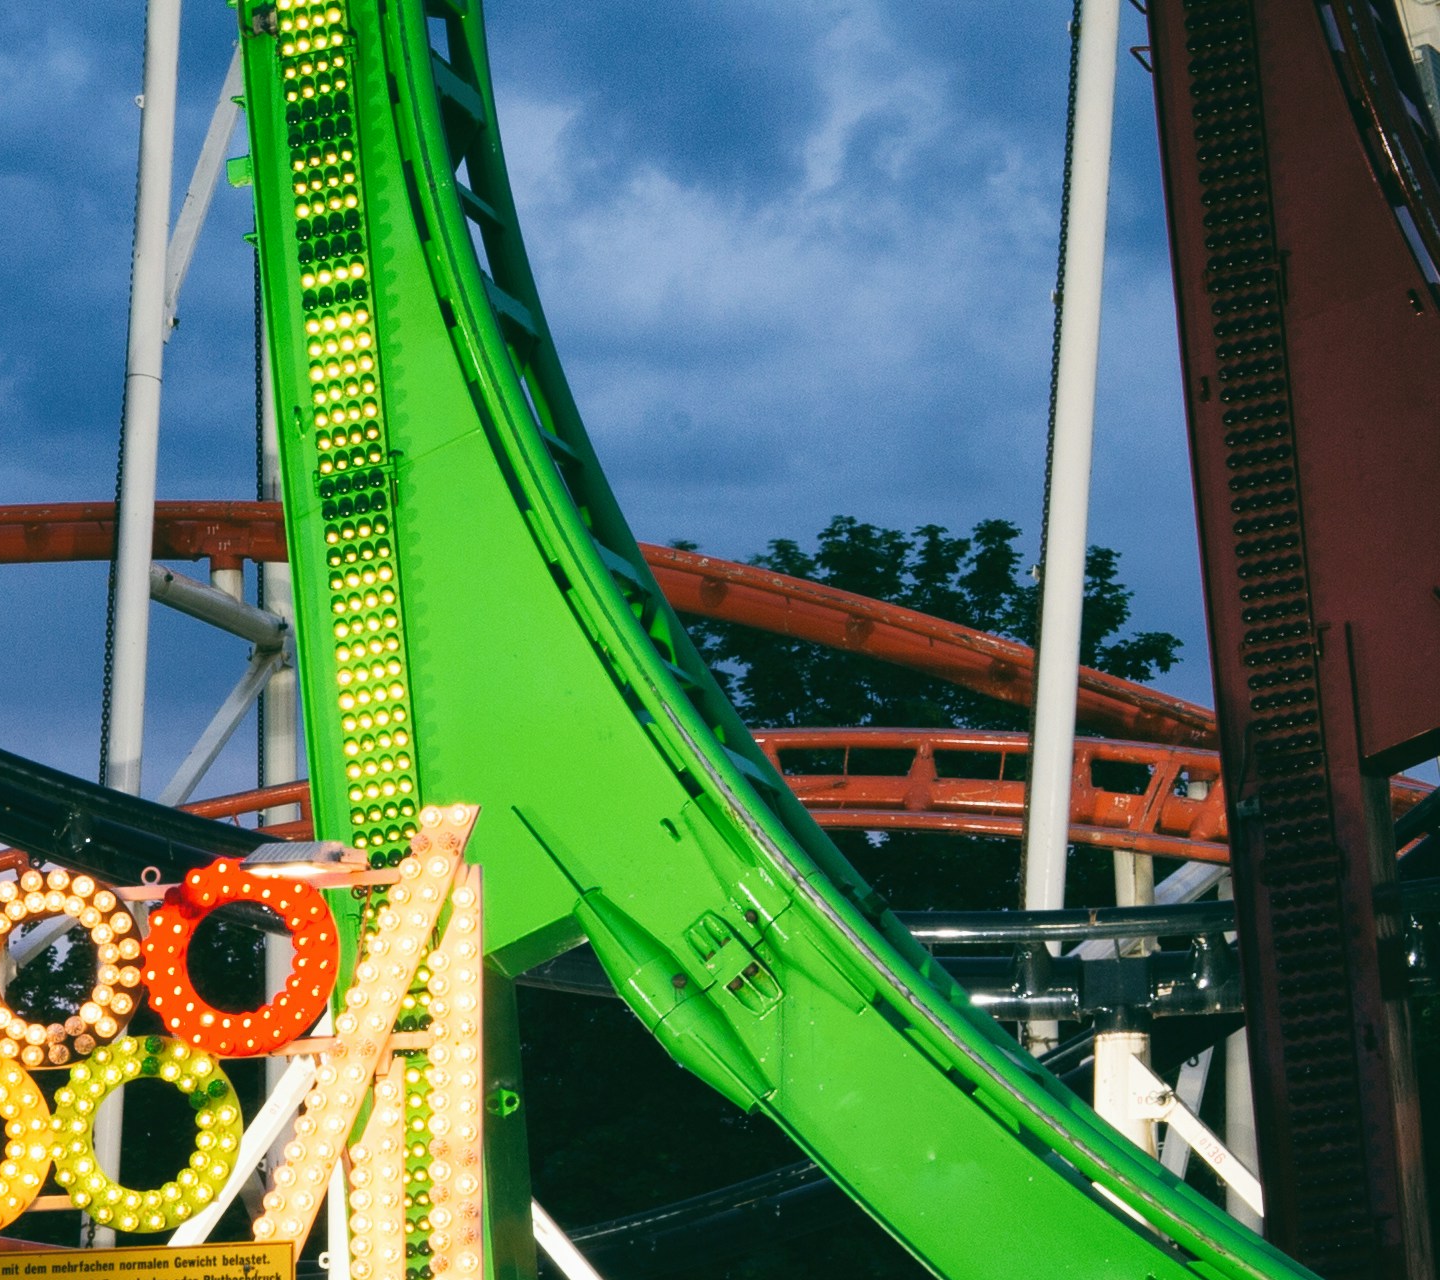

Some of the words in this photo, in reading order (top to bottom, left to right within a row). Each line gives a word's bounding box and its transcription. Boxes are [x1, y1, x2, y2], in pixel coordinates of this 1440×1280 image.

[2, 1264, 19, 1275] mit
[24, 1263, 47, 1275] dem
[52, 1260, 114, 1273] mehrfachen
[119, 1258, 169, 1270] normalen
[174, 1255, 217, 1269] Gewicht
[222, 1253, 271, 1268] belastet.
